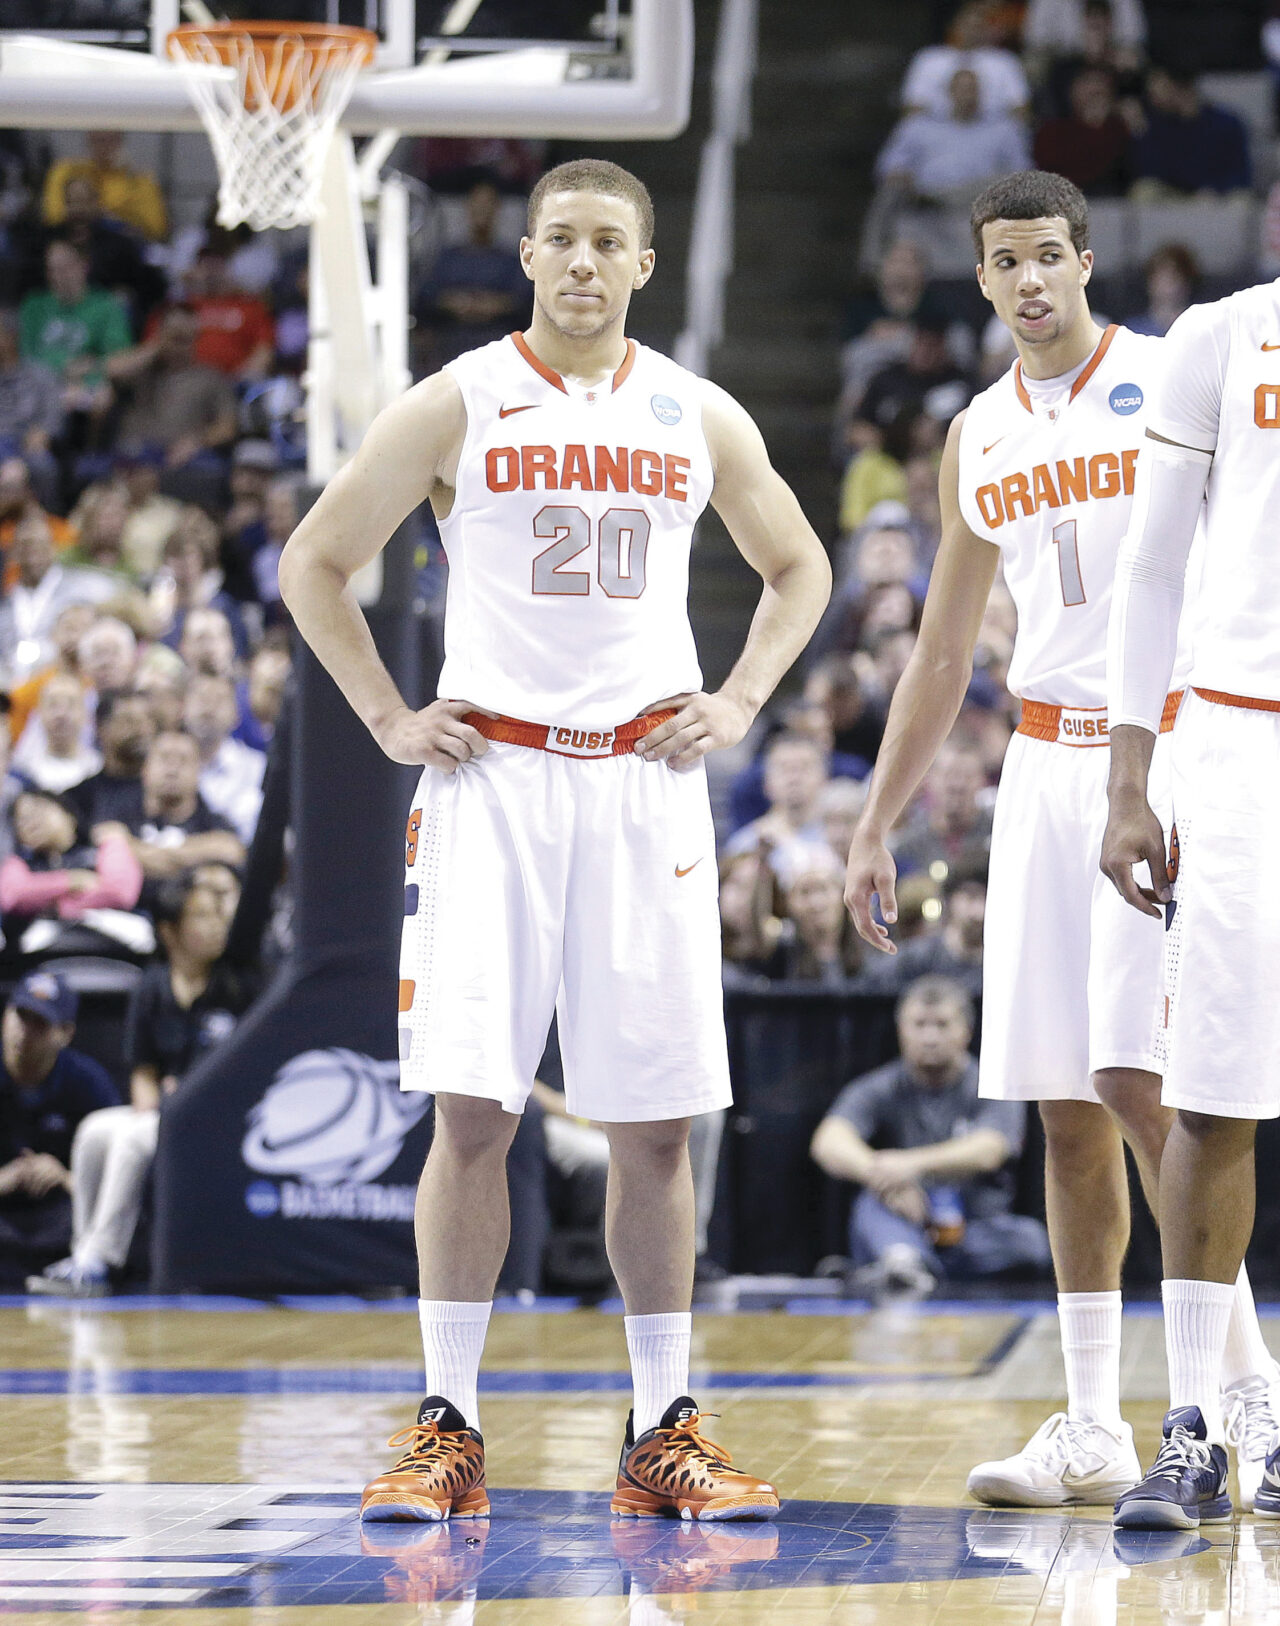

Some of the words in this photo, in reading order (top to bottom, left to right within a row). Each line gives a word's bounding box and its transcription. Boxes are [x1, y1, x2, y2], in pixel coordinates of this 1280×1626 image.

[1113, 397, 1141, 409] NCAA
[484, 444, 691, 502] ORANGE
[532, 505, 651, 600] 20
[1052, 519, 1087, 607] 1
